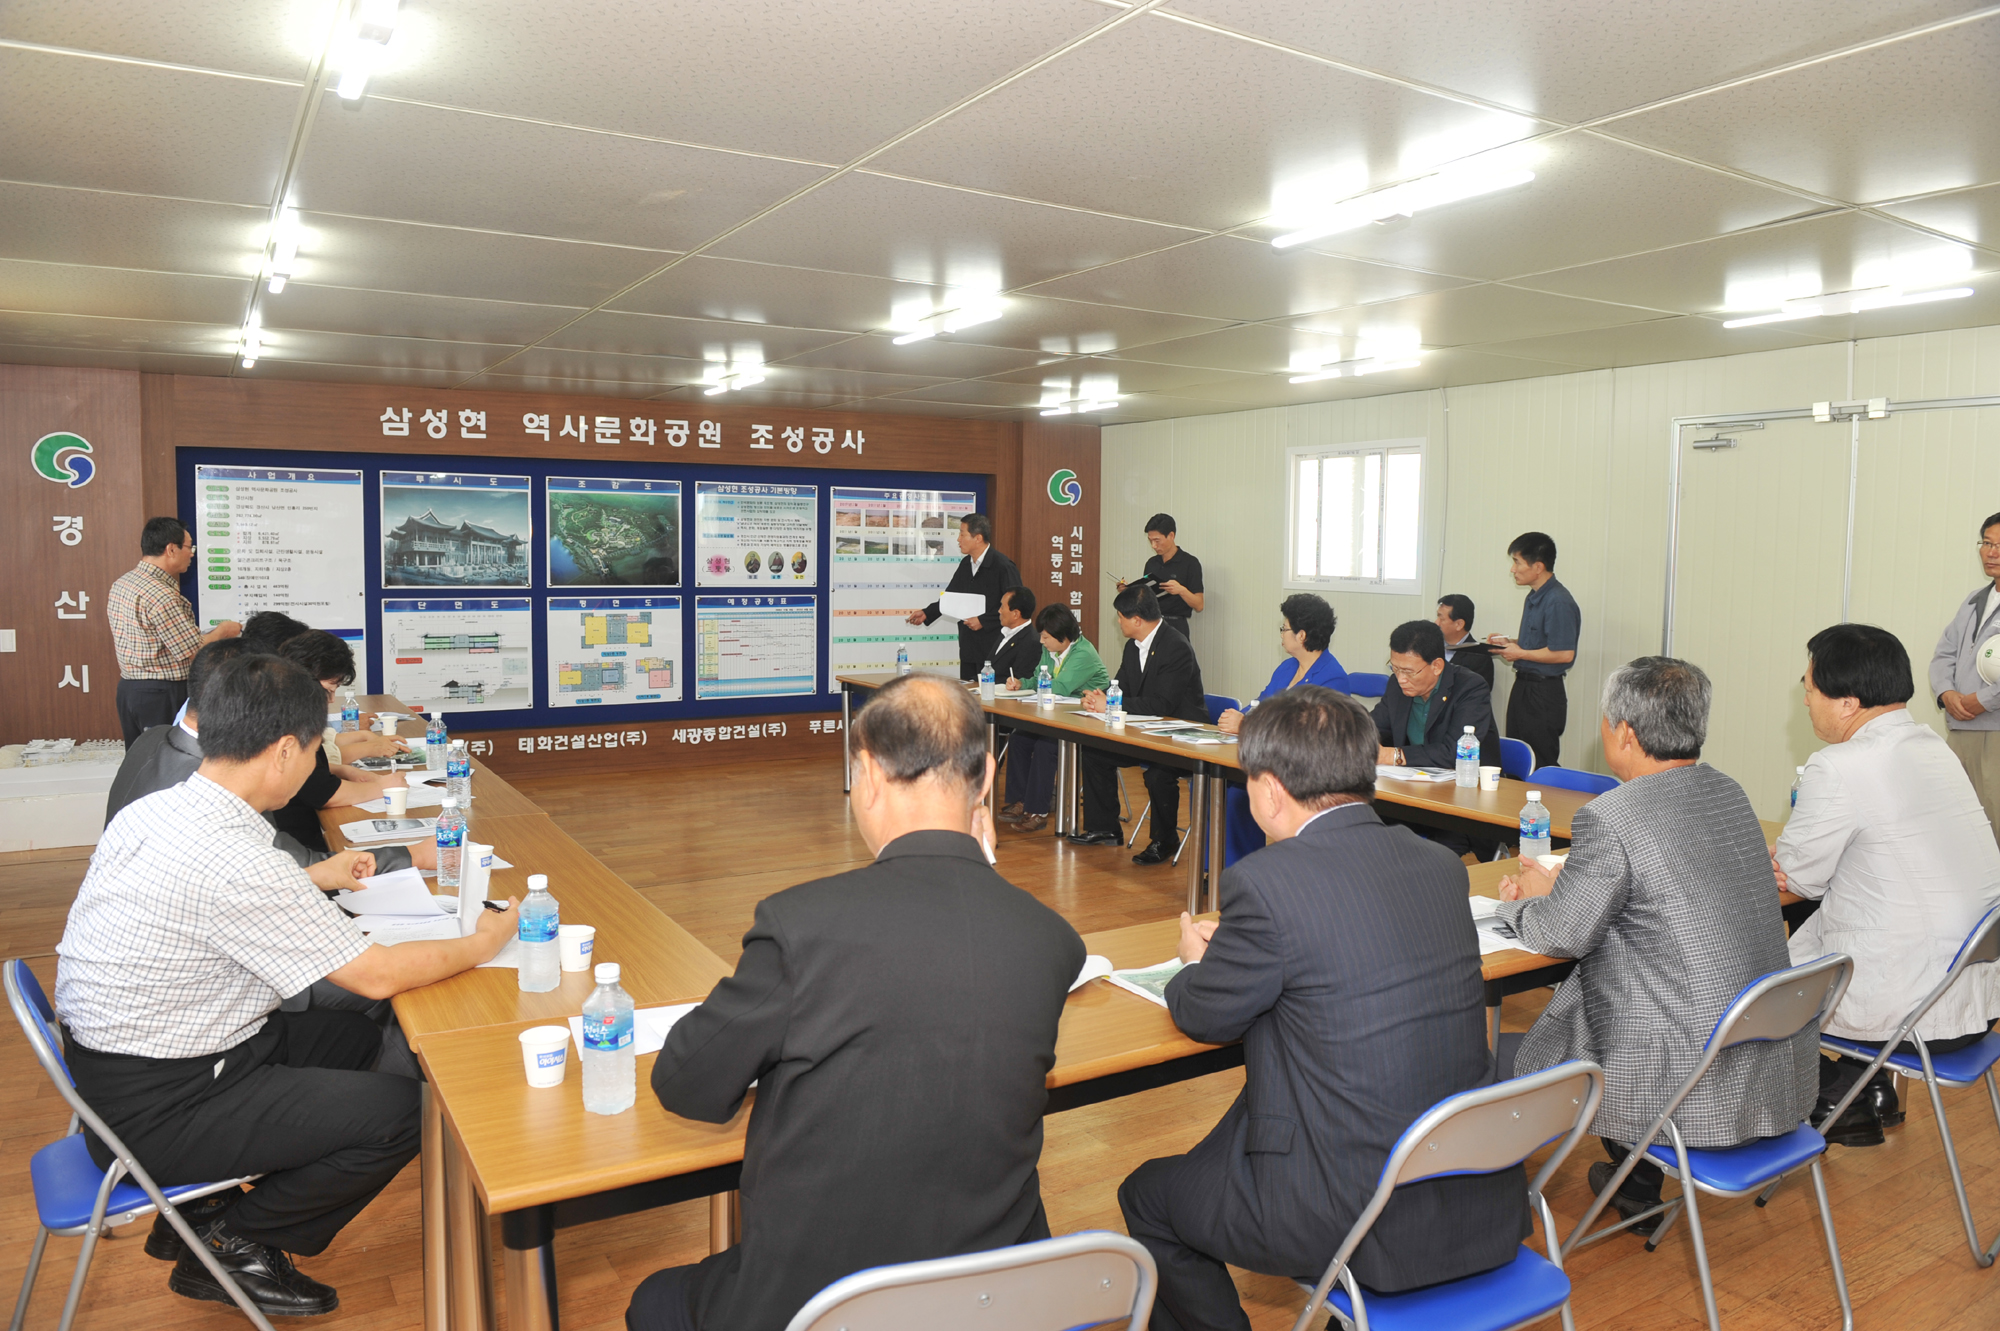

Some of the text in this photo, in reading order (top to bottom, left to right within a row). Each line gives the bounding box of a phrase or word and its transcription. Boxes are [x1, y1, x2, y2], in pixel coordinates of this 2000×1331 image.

[380, 406, 866, 455] 삼성현 역사문화공원 조성공사
[717, 484, 798, 495] 삼성현 조성공사 기본방향
[1051, 535, 1063, 587] 역동적
[1070, 526, 1083, 575] 시민과
[52, 516, 90, 693] 경산시
[518, 730, 647, 753] 태화건설산업(주)
[672, 722, 787, 744] 세광종합건설(주)
